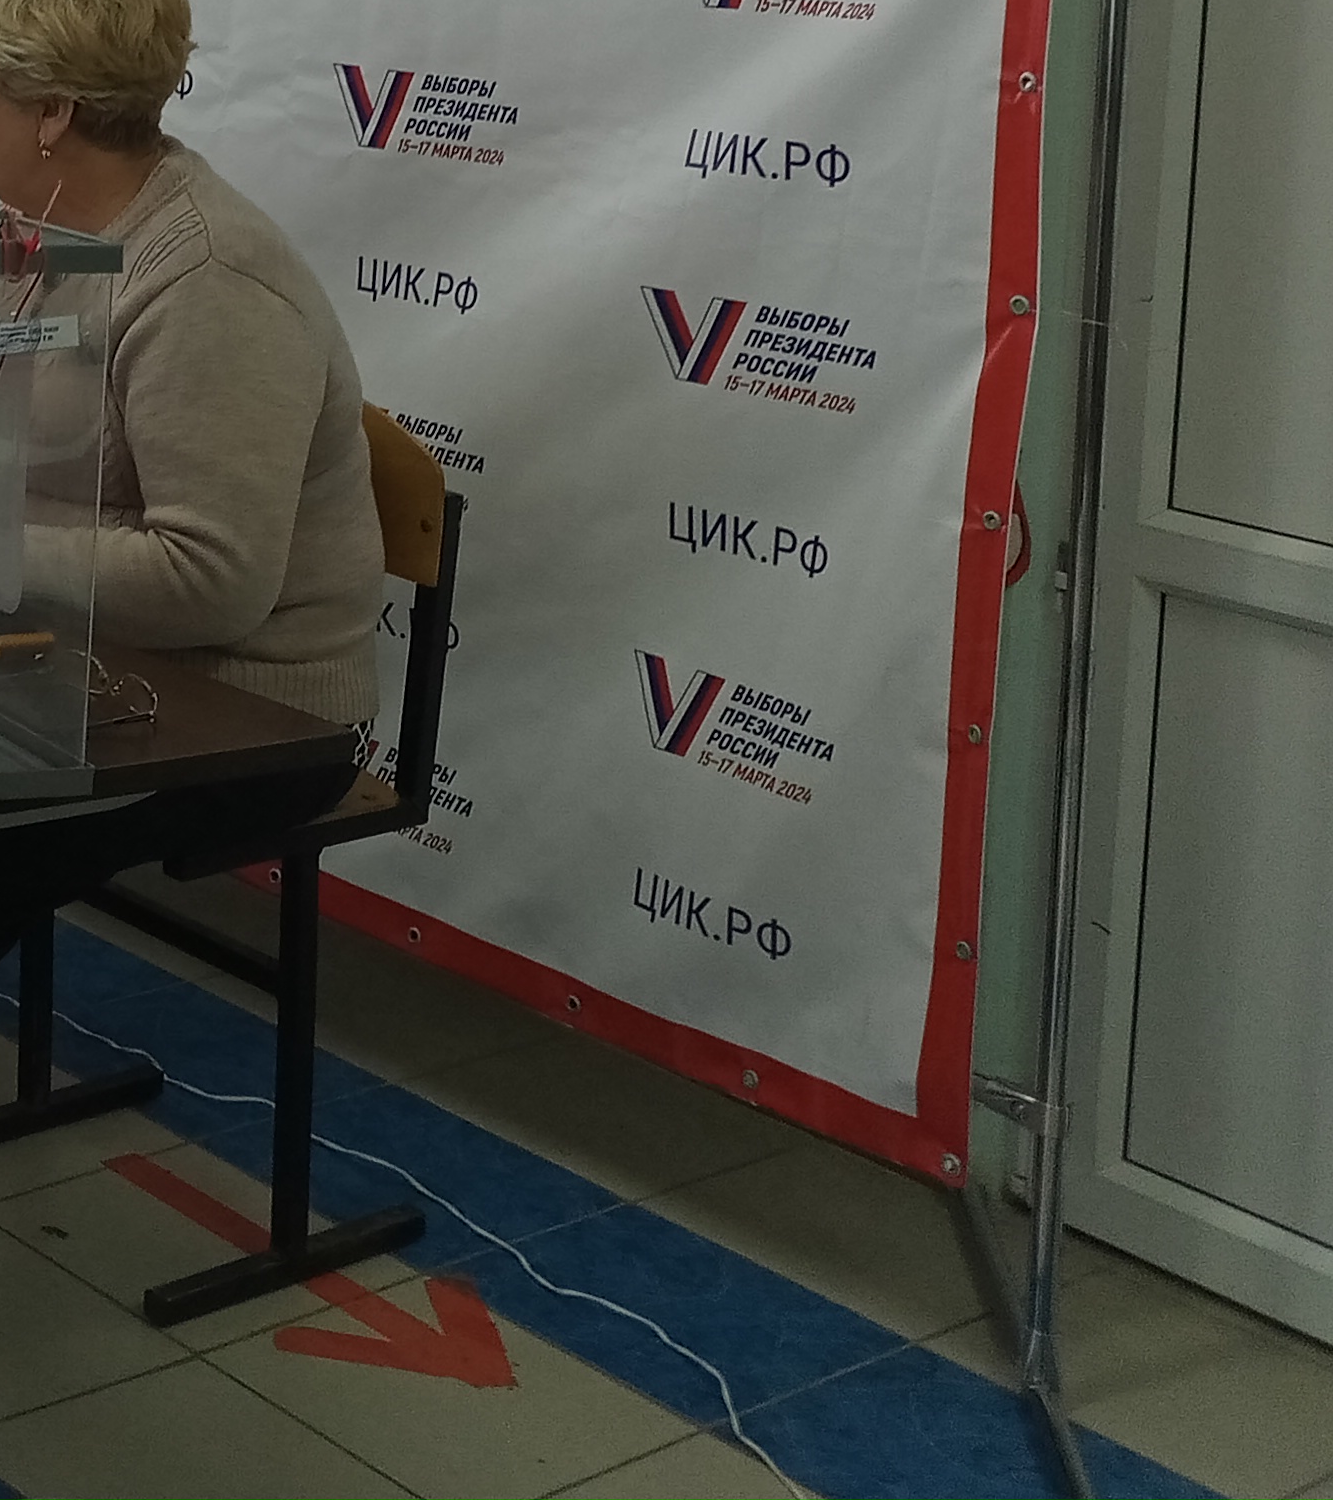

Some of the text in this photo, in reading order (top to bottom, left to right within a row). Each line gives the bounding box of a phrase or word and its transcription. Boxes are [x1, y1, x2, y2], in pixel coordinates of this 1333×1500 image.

[794, 0, 842, 18] МАРТА
[841, 3, 876, 20] 2024
[421, 74, 496, 98] ВЫБОРЫ
[404, 118, 471, 141] РОССИИ
[413, 96, 519, 124] ПРЕЗИДЕНТА
[432, 144, 473, 162] МАРТА
[474, 149, 504, 166] 2024
[683, 128, 852, 189] ЦИК.РФ
[355, 255, 479, 315] ЦИК.РФ
[755, 306, 850, 337] ВЫБОРЫ
[732, 353, 819, 383] РОССИИ
[744, 329, 877, 369] ПРЕЗИДЕНТА
[764, 383, 817, 407] МАРТА
[817, 393, 856, 415] 2024
[668, 501, 830, 579] ЦИК.РФ
[731, 684, 811, 726] ВЫБОРЫ
[707, 729, 780, 769] РОССИИ
[719, 707, 834, 761] ПРЕЗИДЕНТА
[732, 763, 776, 793] МАРТА
[775, 780, 812, 805] 2024
[632, 867, 793, 962] ЦИК.РФ
